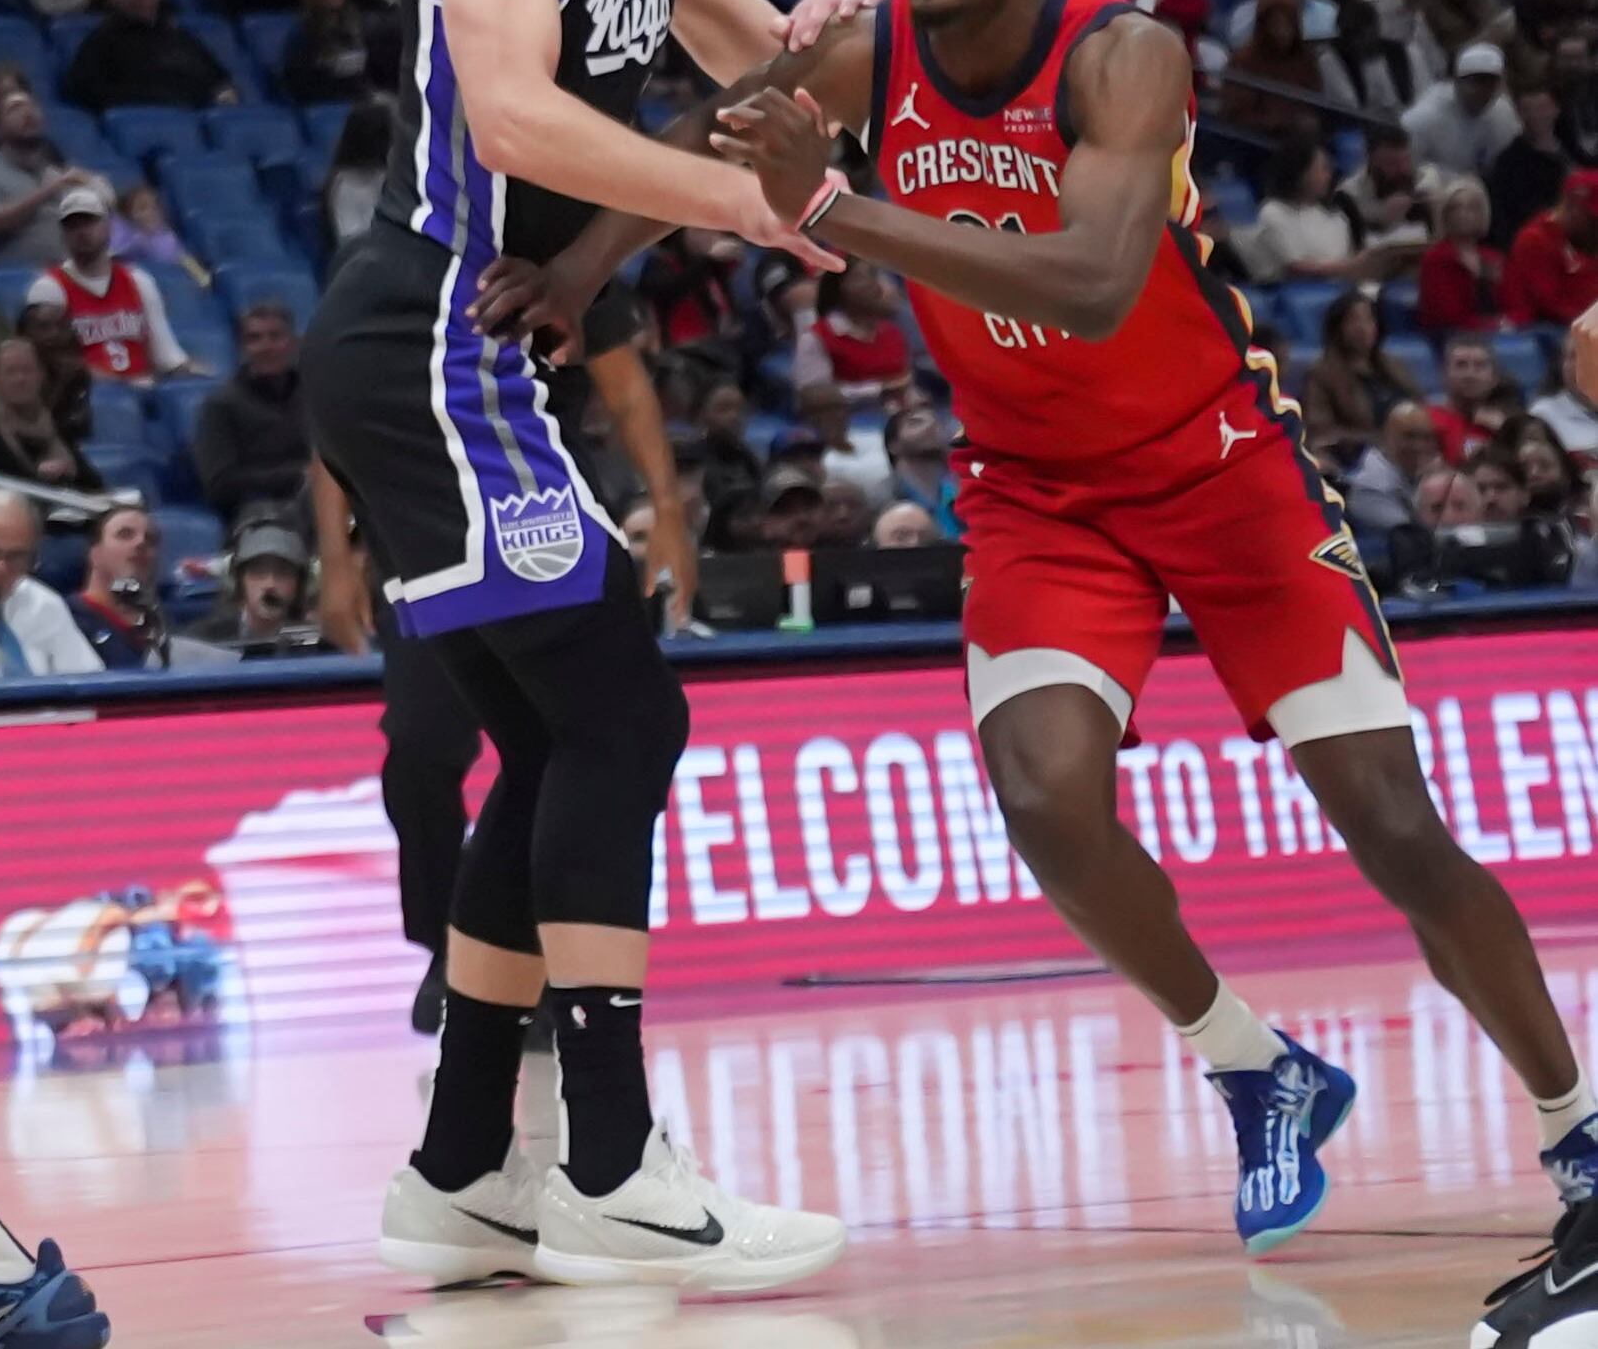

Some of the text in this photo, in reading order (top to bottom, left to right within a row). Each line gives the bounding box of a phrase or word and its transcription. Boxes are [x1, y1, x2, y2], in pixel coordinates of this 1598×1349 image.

[896, 138, 1060, 197] CRESCENT
[502, 523, 578, 552] KINGS
[648, 730, 1042, 929] ELCOM
[1117, 738, 1217, 863] TO
[1220, 736, 1348, 857] TH
